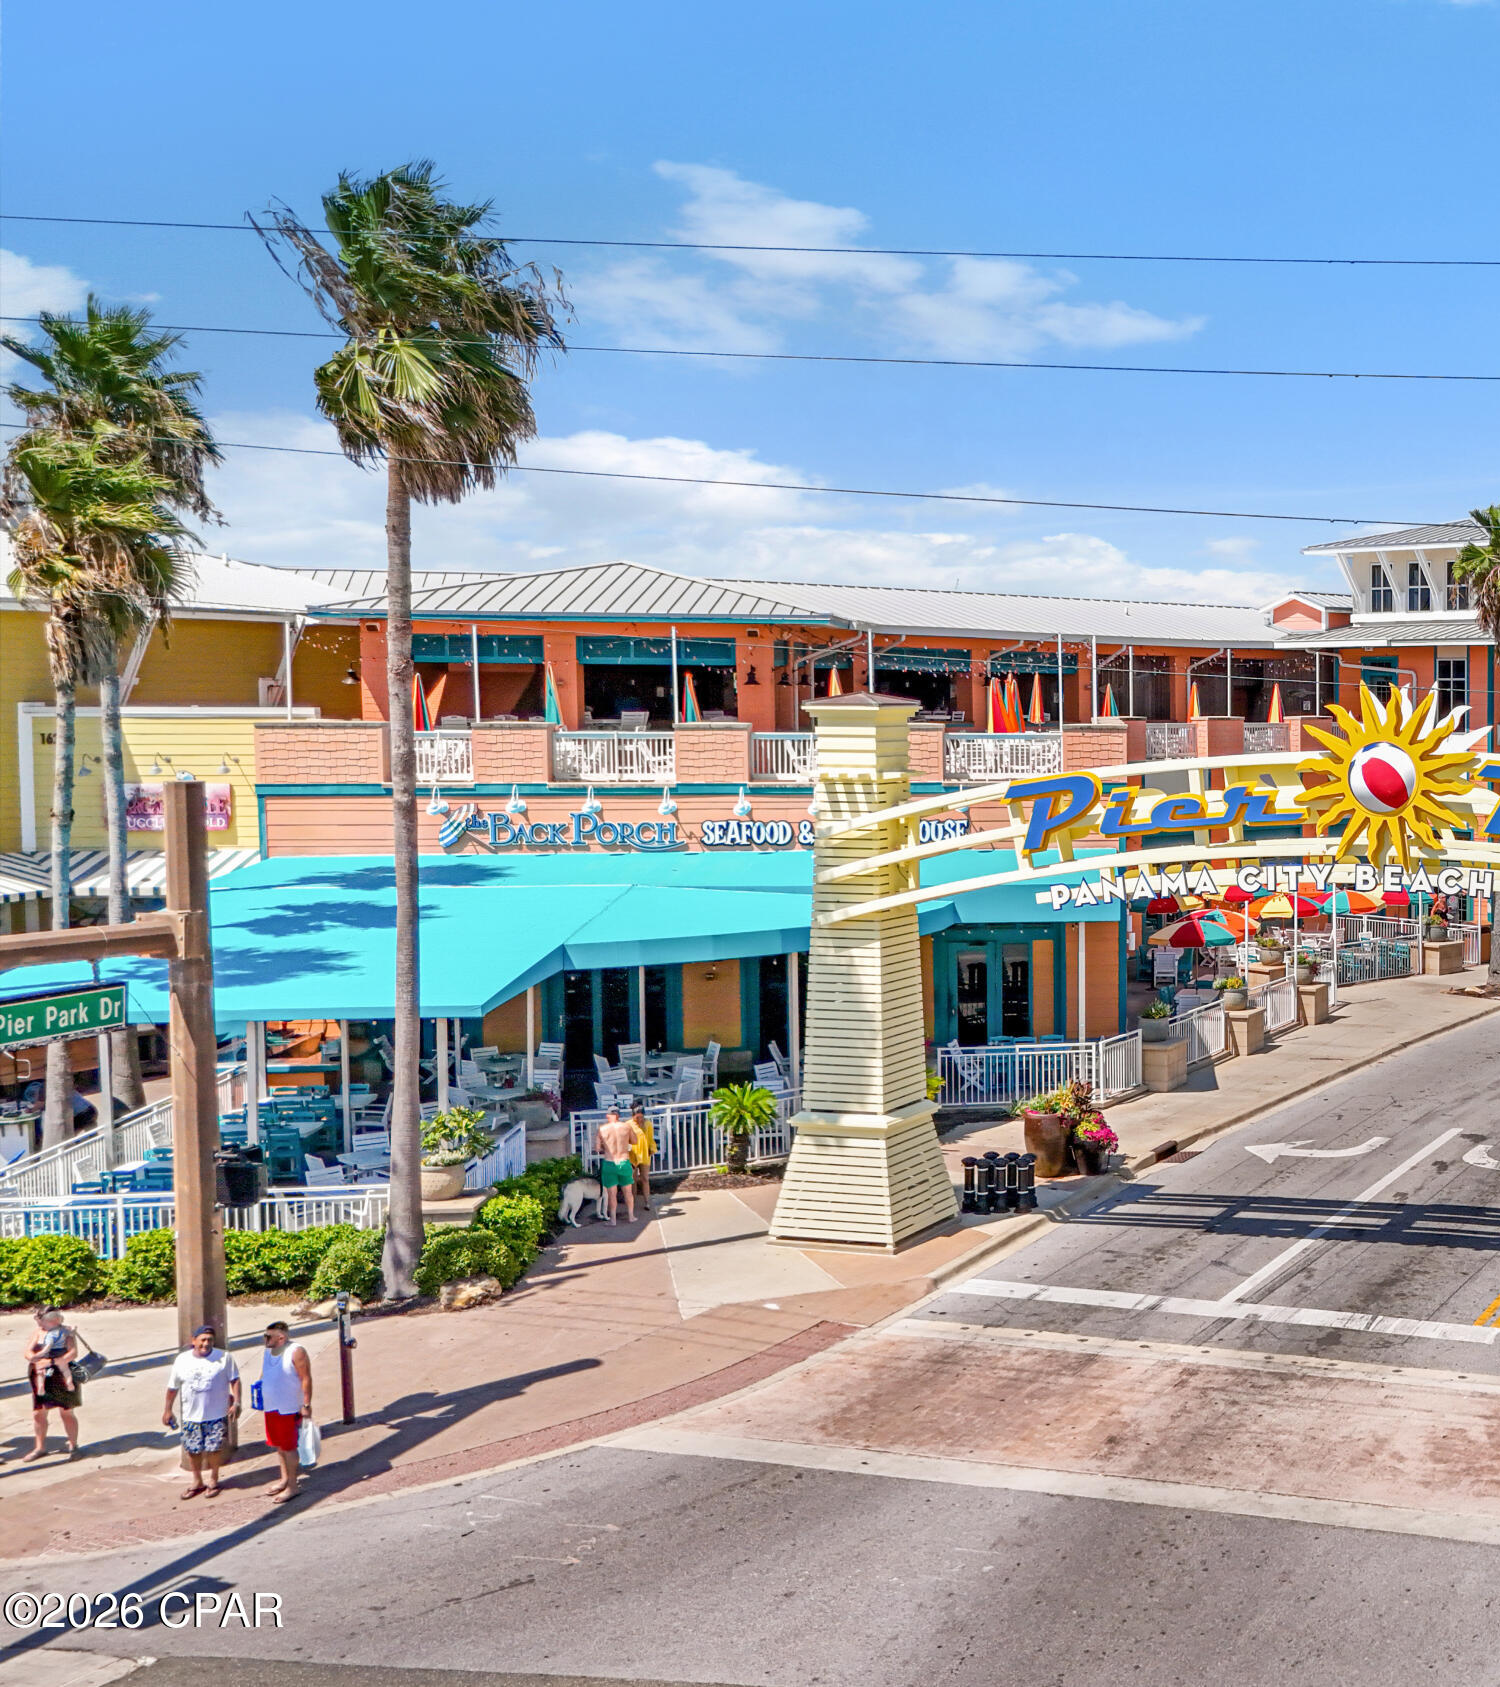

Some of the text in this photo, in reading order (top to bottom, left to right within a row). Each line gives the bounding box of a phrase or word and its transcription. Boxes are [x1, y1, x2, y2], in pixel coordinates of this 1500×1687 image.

[464, 813, 488, 830] the
[1001, 771, 1312, 857] Pier
[701, 819, 971, 846] SEAFOOD & OUSE
[1050, 864, 1219, 912] PANAMA
[1235, 863, 1334, 893] CITY
[1354, 863, 1494, 899] BEACH
[45, 1001, 89, 1030] Park
[99, 996, 121, 1020] Dr
